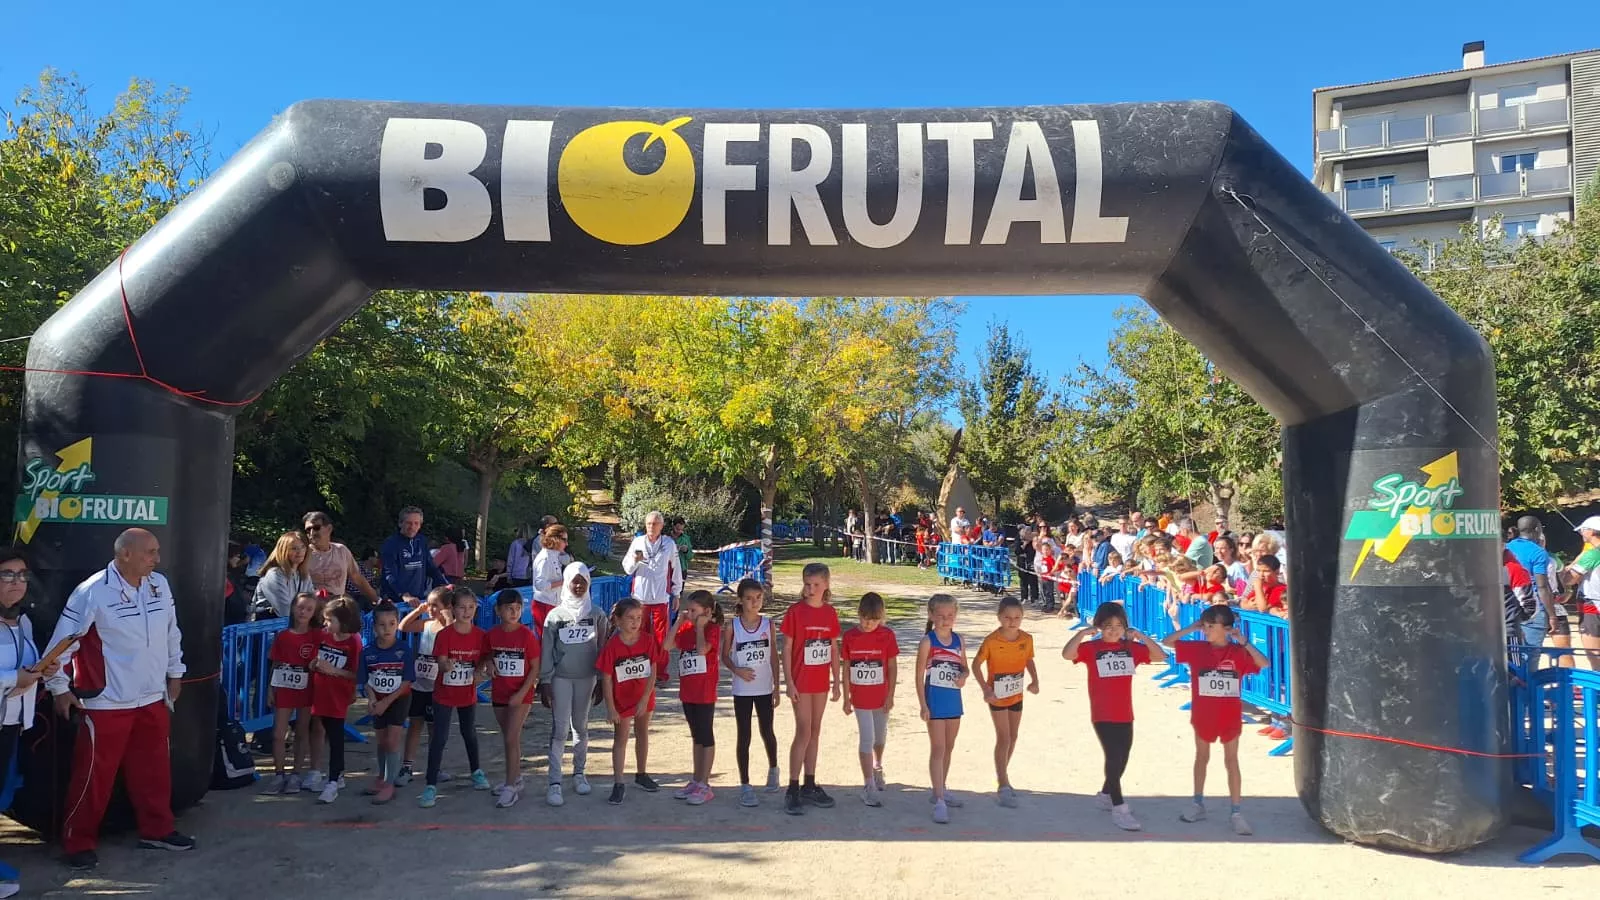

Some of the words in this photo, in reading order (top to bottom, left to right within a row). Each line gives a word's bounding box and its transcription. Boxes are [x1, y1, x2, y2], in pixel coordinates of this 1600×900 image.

[379, 115, 1130, 249] BIOFRUTAL
[24, 459, 94, 500] Sport
[1371, 476, 1461, 518] Sport
[35, 496, 160, 521] BIOFRUTAL
[568, 628, 588, 639] 272
[746, 650, 765, 662] 269
[812, 648, 828, 659] 044
[417, 662, 433, 673] 097
[498, 660, 516, 671] 015
[625, 664, 645, 675] 090
[1106, 661, 1127, 672] 183
[281, 672, 301, 684] 149
[450, 670, 469, 681] 011
[857, 669, 877, 680] 070
[374, 677, 395, 688] 080
[1209, 679, 1231, 691] 091
